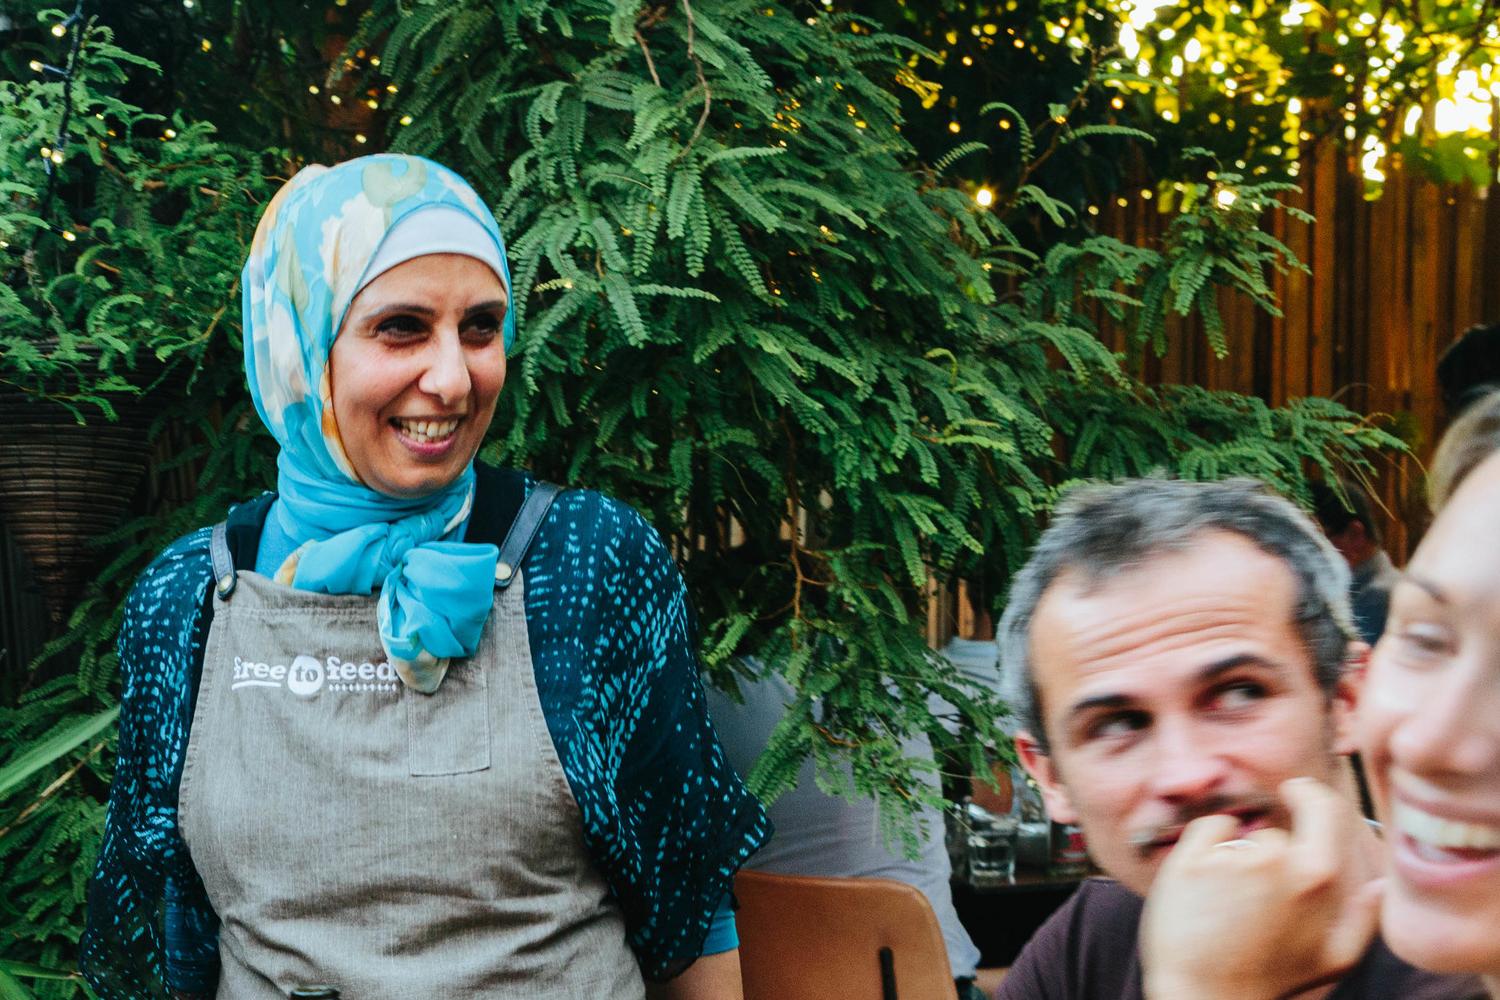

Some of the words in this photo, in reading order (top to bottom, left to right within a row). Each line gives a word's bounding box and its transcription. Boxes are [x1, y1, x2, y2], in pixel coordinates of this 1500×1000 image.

[233, 656, 287, 680] free
[295, 665, 319, 682] to
[326, 656, 398, 681] feed
